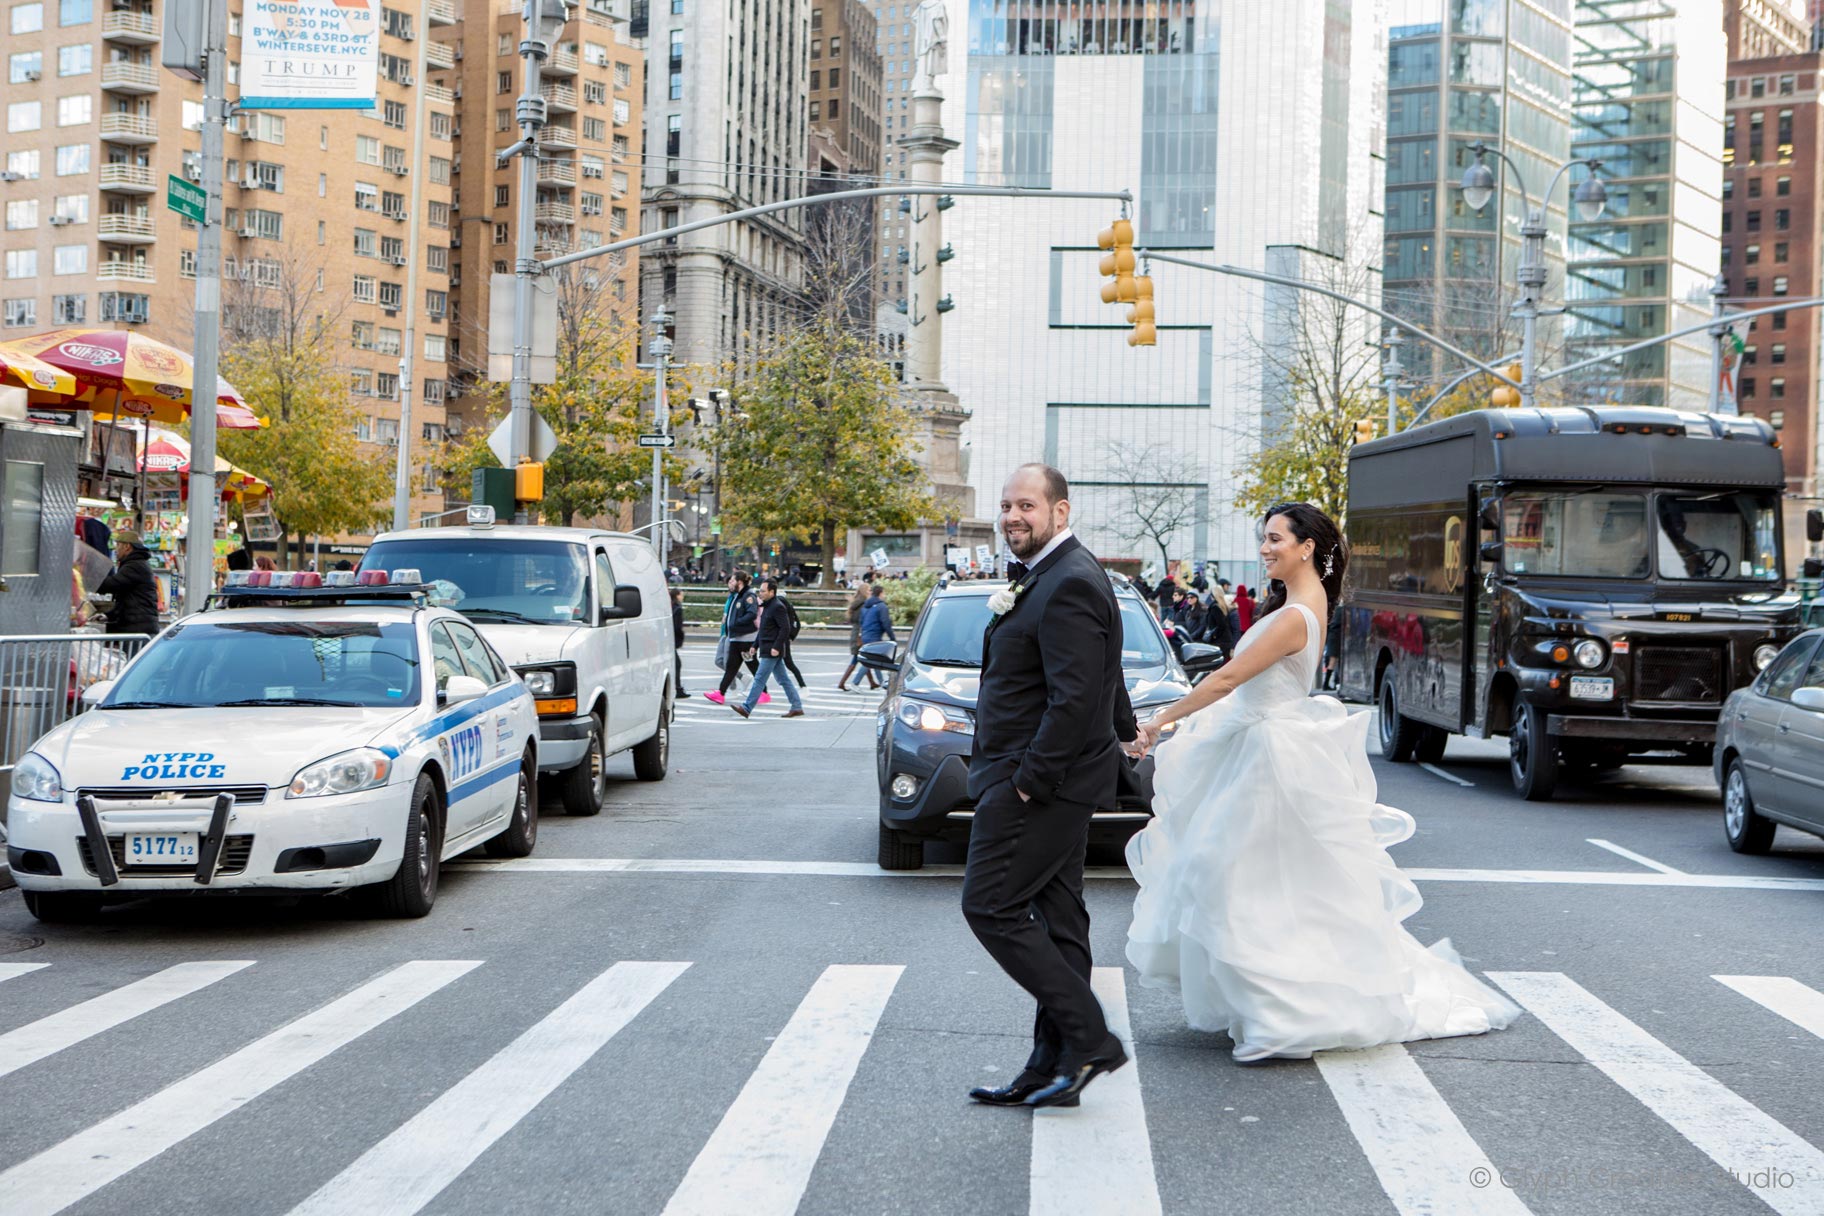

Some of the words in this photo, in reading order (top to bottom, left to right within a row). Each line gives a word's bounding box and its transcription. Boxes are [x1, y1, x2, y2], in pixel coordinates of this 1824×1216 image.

[257, 3, 315, 15] MONDAY
[320, 9, 349, 19] NOV
[354, 11, 370, 20] 28
[286, 18, 316, 28] 5:30
[321, 21, 340, 30] PM
[253, 27, 294, 40] B'WAY
[299, 31, 308, 40] &
[313, 32, 349, 43] 63RD
[257, 40, 367, 55] WINTERSEVE.NYC
[264, 60, 355, 76] TRUMP
[68, 345, 113, 359] NIKAS
[141, 753, 214, 763] NYPD
[450, 725, 482, 781] NYPD
[120, 765, 226, 780] POLICE
[132, 837, 178, 855] 5177
[180, 846, 193, 855] 12
